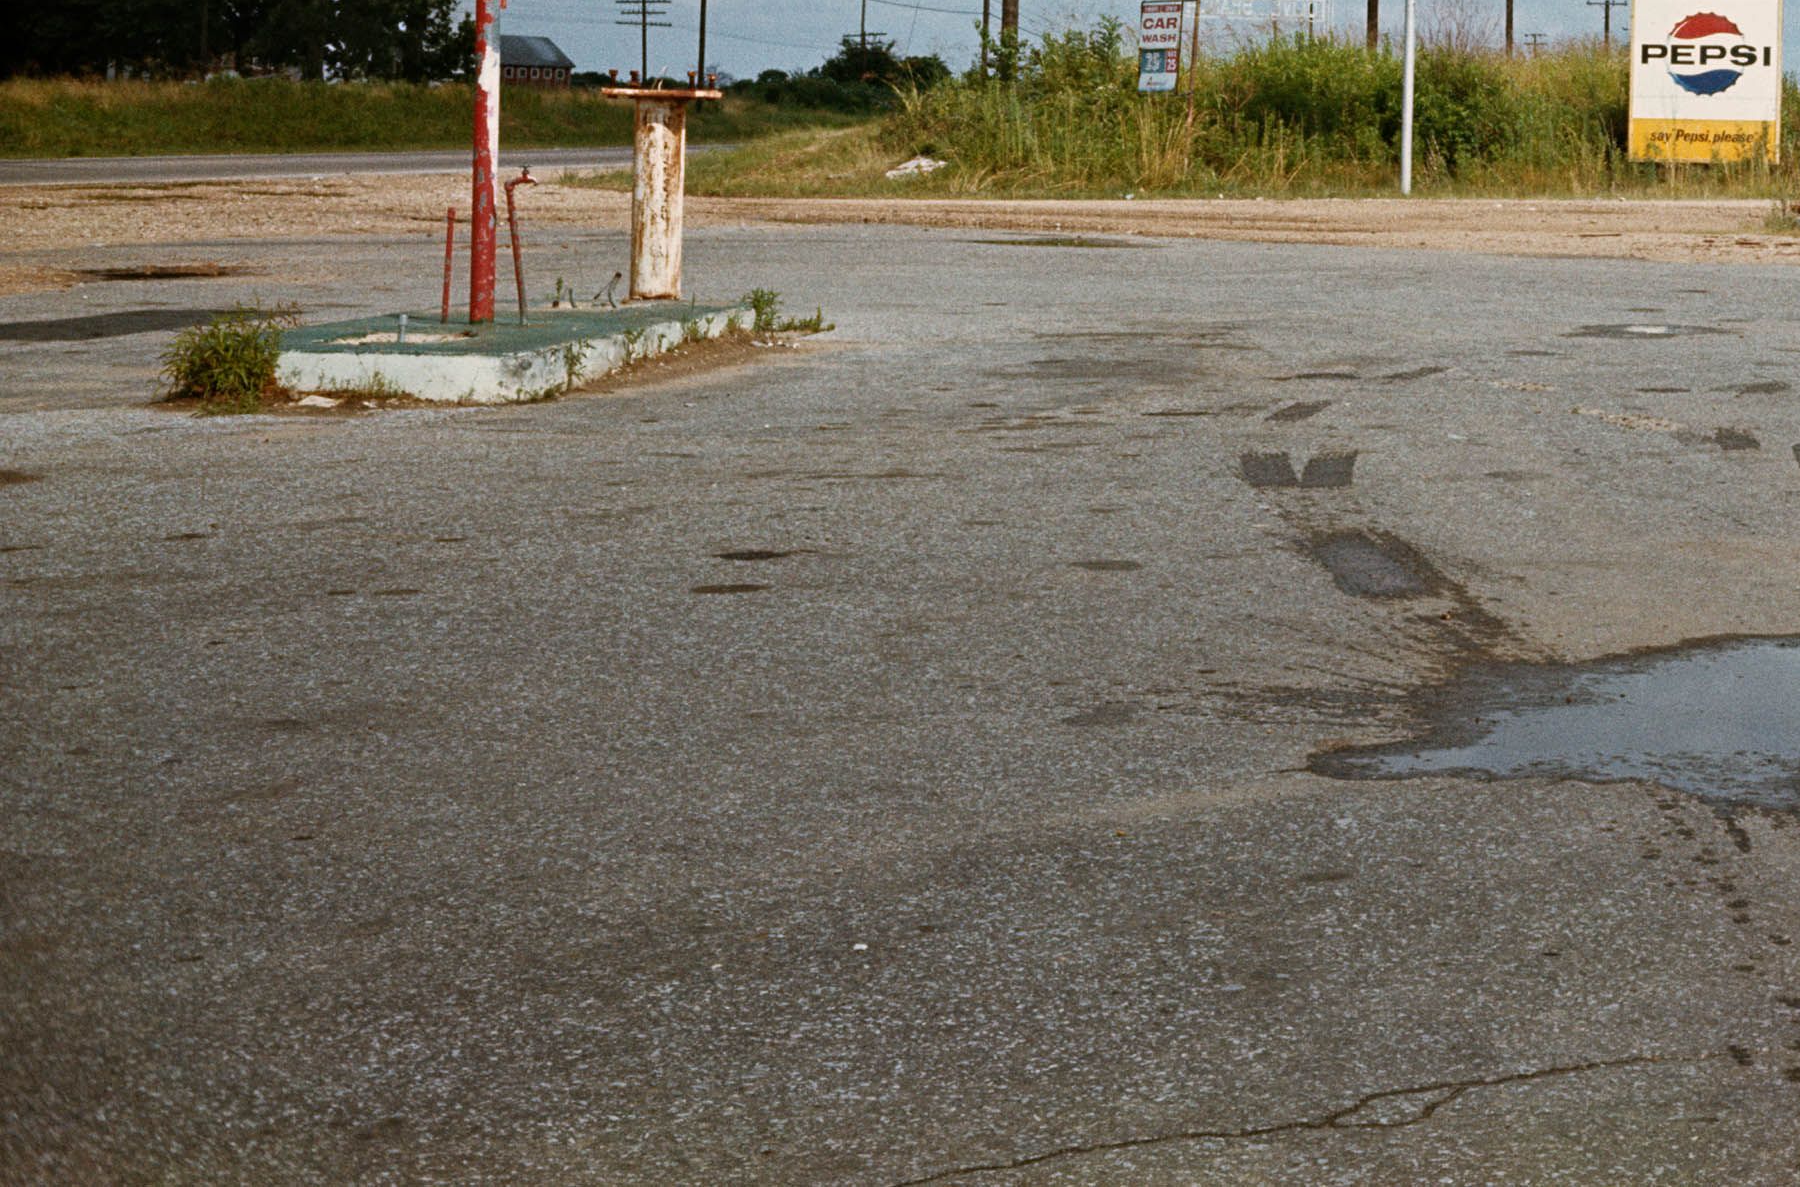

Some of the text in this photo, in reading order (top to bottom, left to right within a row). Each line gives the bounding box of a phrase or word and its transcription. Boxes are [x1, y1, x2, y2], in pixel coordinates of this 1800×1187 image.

[1143, 17, 1178, 30] CAR
[1142, 33, 1177, 43] WASH
[1640, 43, 1771, 67] PEPSI
[1650, 131, 1672, 143] say
